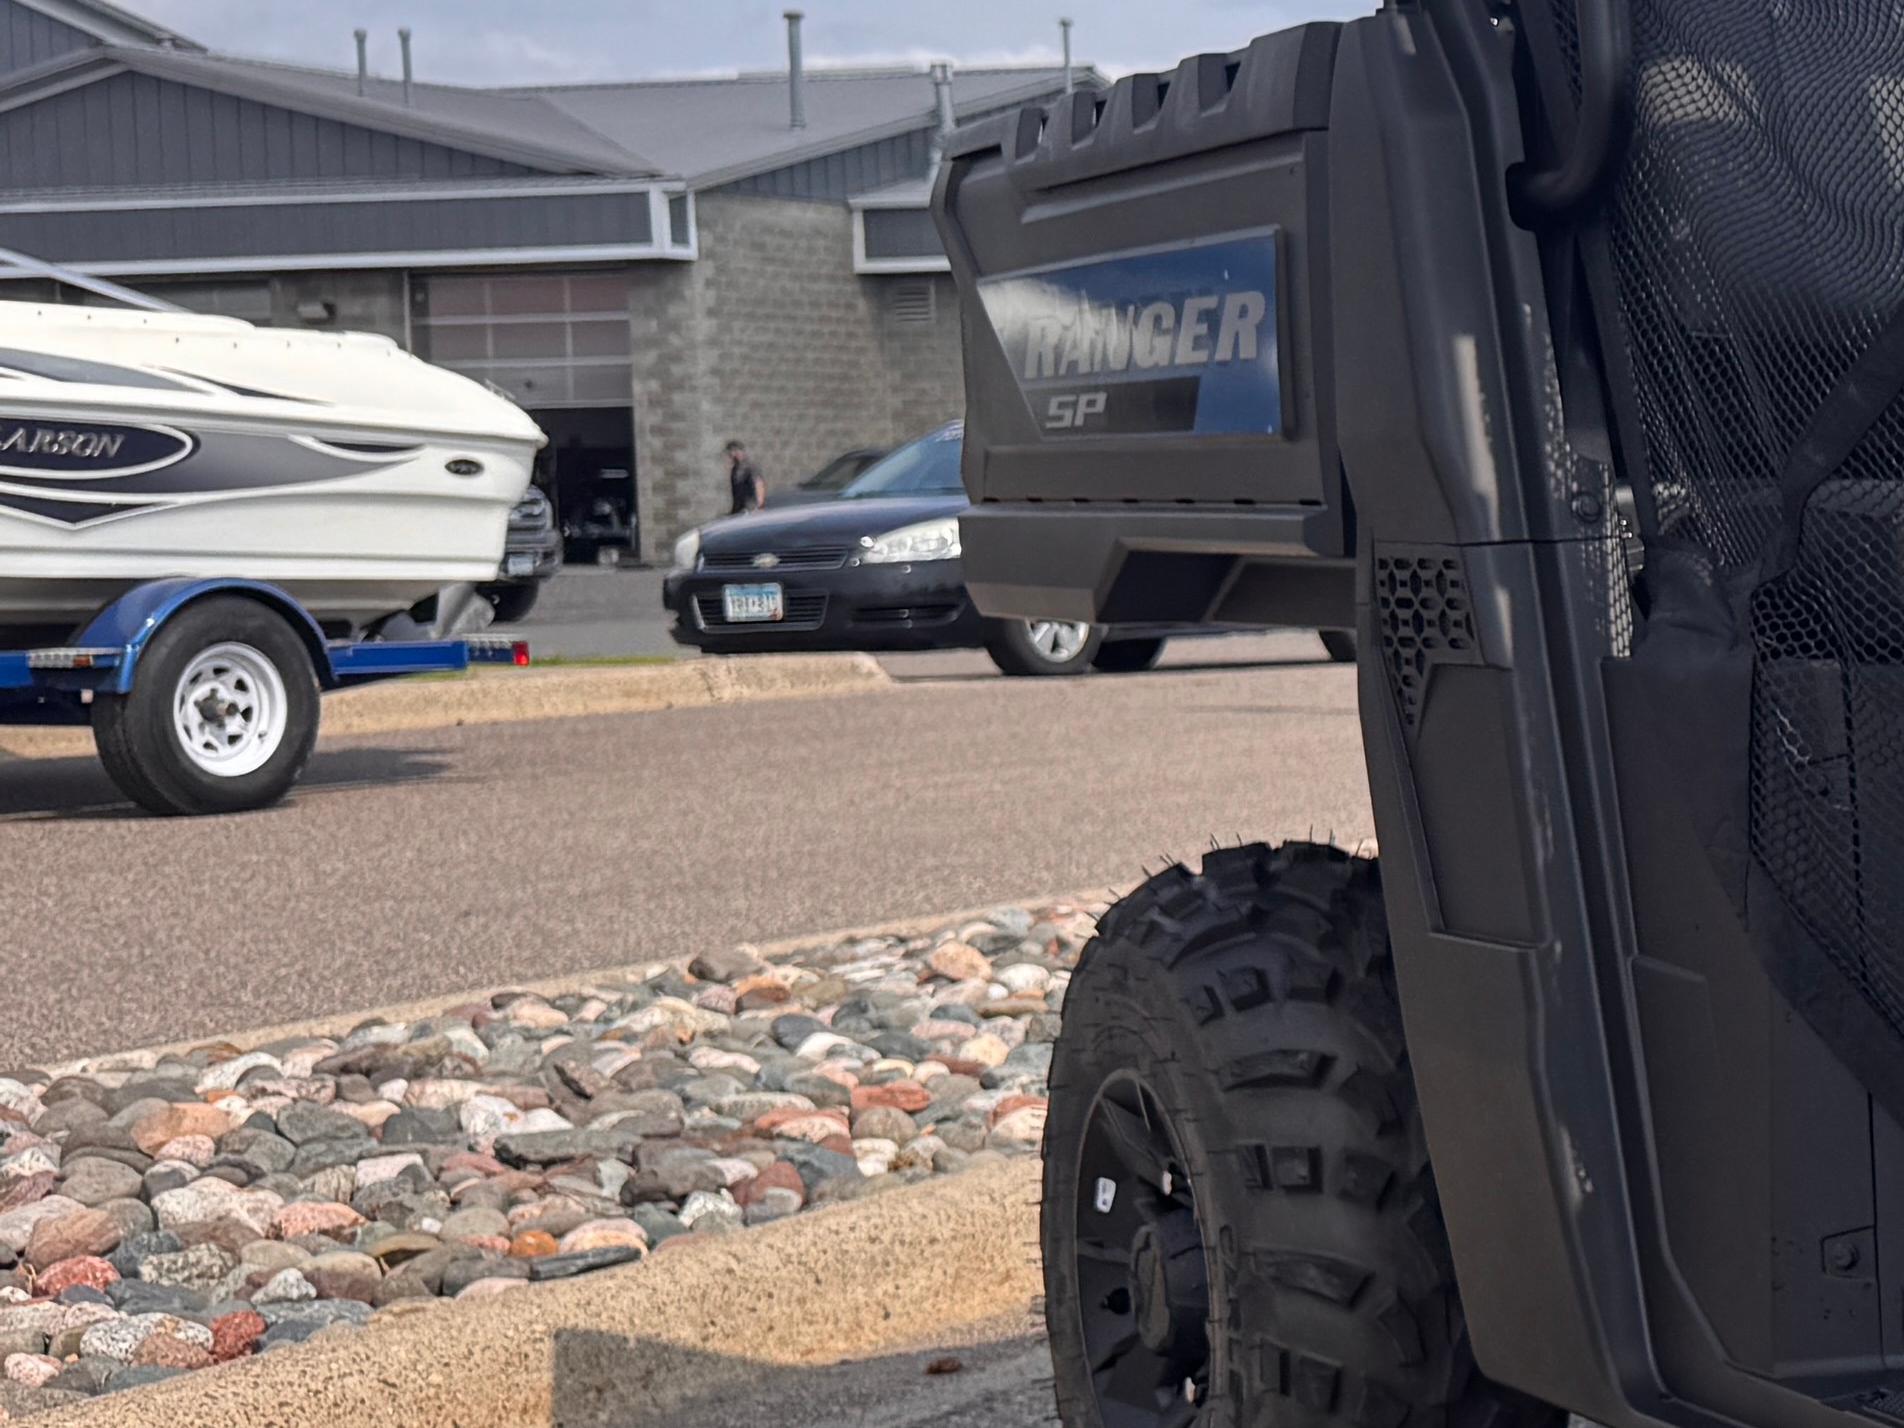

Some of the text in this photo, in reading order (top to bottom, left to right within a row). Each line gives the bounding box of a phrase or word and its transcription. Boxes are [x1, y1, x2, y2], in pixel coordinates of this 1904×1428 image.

[1023, 289, 1267, 379] RANGER
[1045, 391, 1108, 429] SP
[0, 426, 126, 459] ARSON
